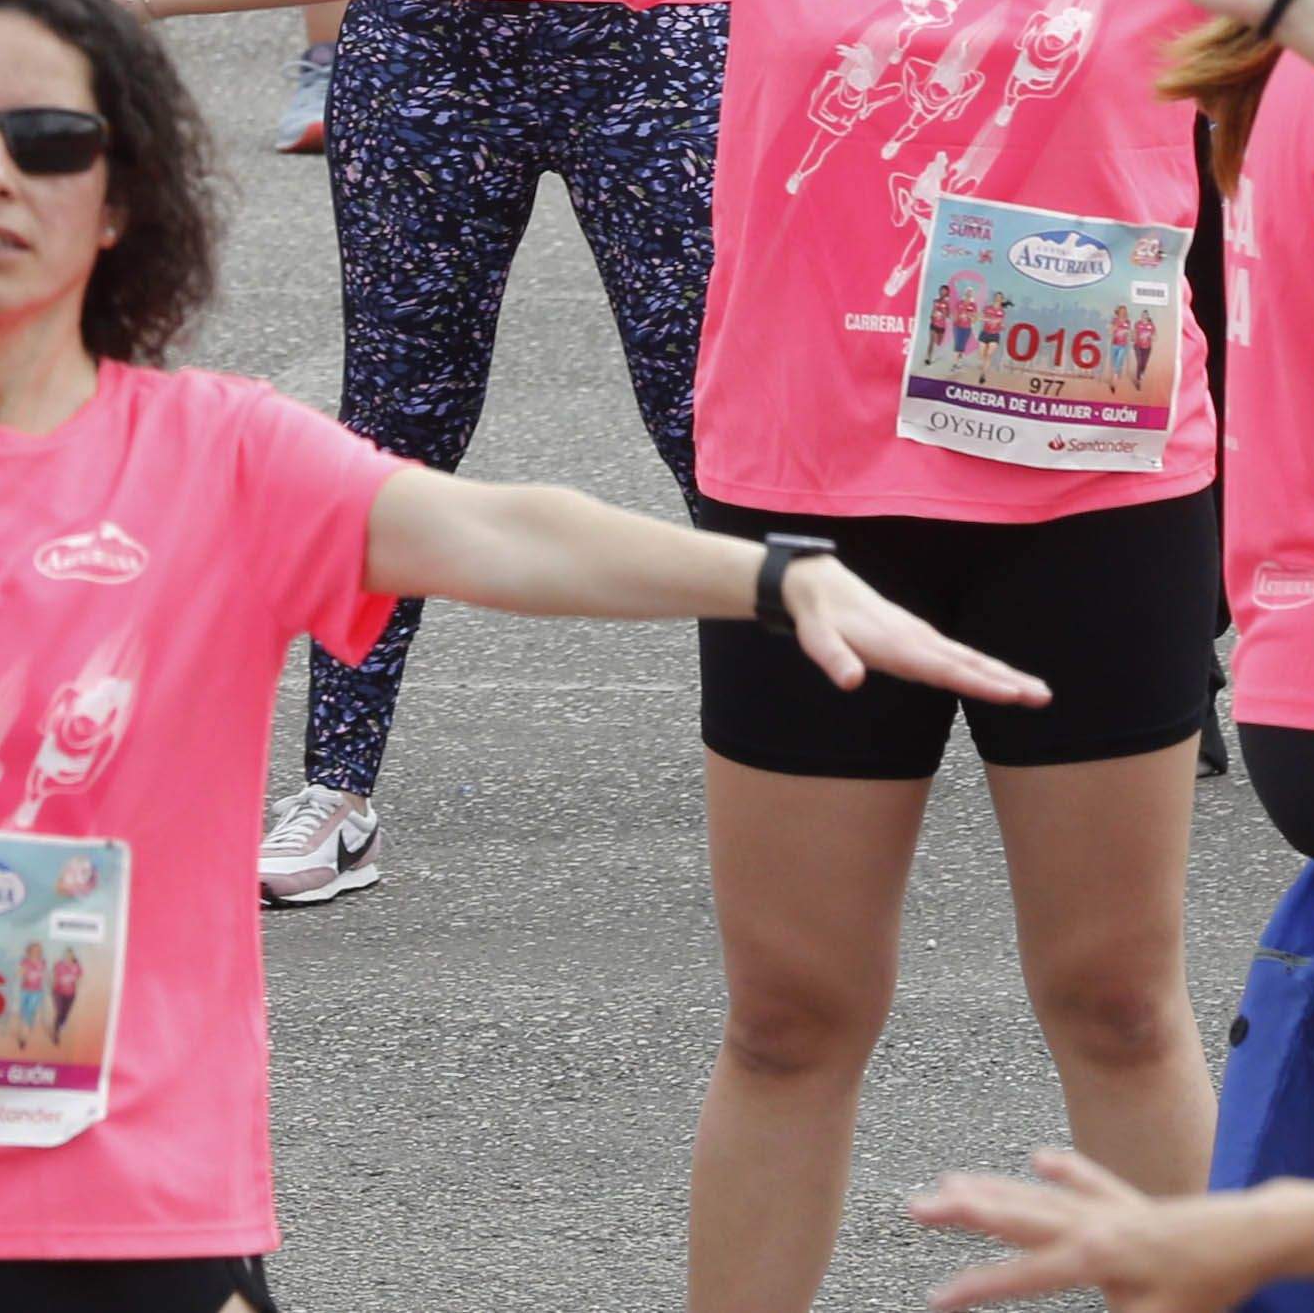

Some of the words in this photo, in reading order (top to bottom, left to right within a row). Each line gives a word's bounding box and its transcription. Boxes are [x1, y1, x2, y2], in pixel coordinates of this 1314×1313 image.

[845, 313, 905, 334] CARRERA
[1005, 322, 1103, 370] 016
[1029, 376, 1066, 397] 977
[945, 385, 1006, 411] CARRERA
[1009, 397, 1026, 413] DE
[1030, 400, 1048, 417] LA
[1050, 403, 1093, 420] MUJER
[930, 411, 1016, 445] OYSHO
[1067, 436, 1138, 454] Santander
